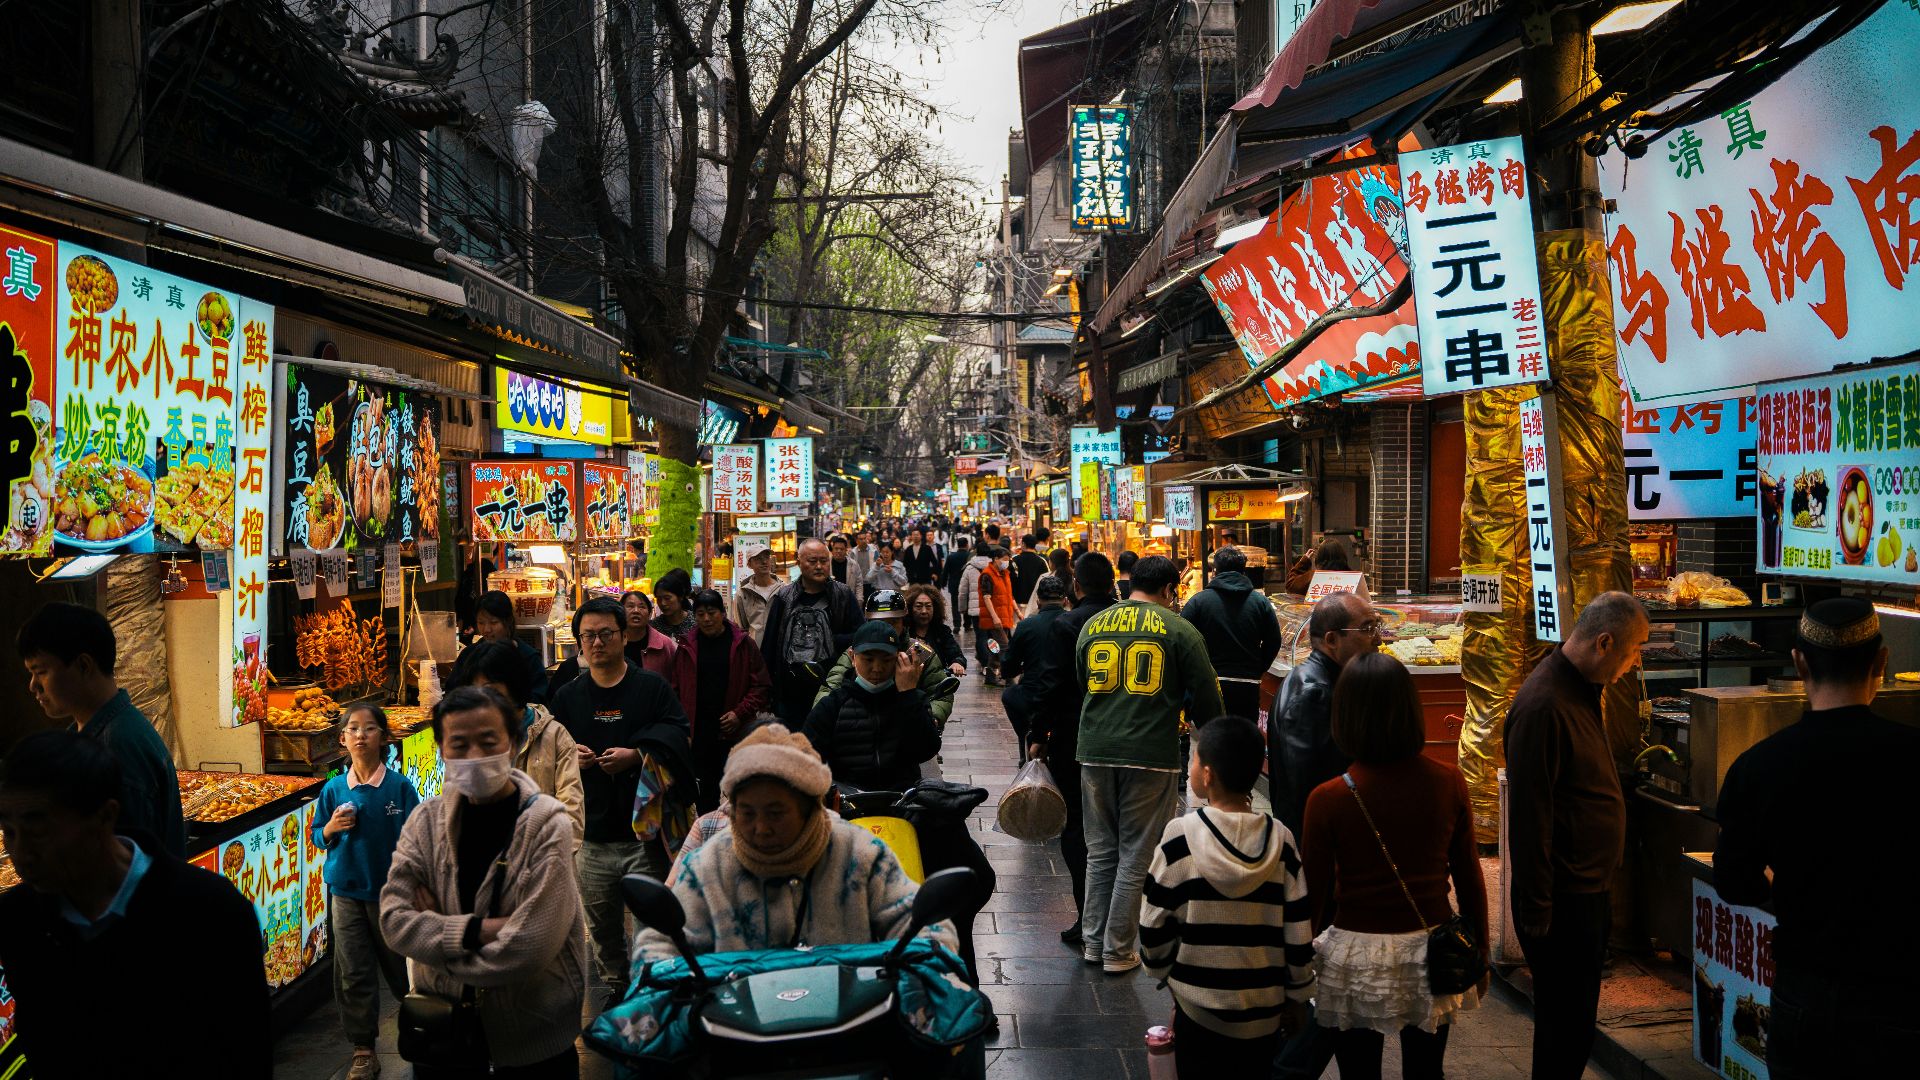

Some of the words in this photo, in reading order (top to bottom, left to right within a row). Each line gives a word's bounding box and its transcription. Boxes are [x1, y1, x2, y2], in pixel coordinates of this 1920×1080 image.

[1430, 143, 1491, 165] 清真
[1668, 101, 1767, 179] 清真
[1404, 158, 1526, 214] 马继烤肉
[3, 246, 42, 301] 真
[132, 275, 185, 311] 清真
[1426, 211, 1510, 386] 一元一串
[65, 293, 233, 408] 神农小土豆
[1512, 297, 1543, 378] 老三样
[62, 392, 150, 468] 炒凉粉
[163, 407, 234, 475] 香豆腐
[351, 414, 397, 469] 肚包肉
[1521, 409, 1543, 438] 马继
[238, 320, 269, 621] 鲜榨石榴汁
[286, 381, 316, 548] 臭豆腐
[399, 402, 417, 543] 铁板鱿鱼
[735, 455, 753, 512] 酸汤水饺
[778, 445, 801, 498] 张庆烤肉
[1523, 443, 1546, 473] 烤肉
[22, 505, 38, 529] 起
[474, 479, 570, 539] 一元一串
[587, 483, 628, 533] 一元一串
[1528, 478, 1556, 638] 一元一串
[1088, 606, 1140, 635] GOLDEN
[1140, 608, 1167, 635] AGE
[1087, 640, 1166, 696] 90
[250, 826, 277, 853] 清真
[266, 888, 301, 946] 香豆腐
